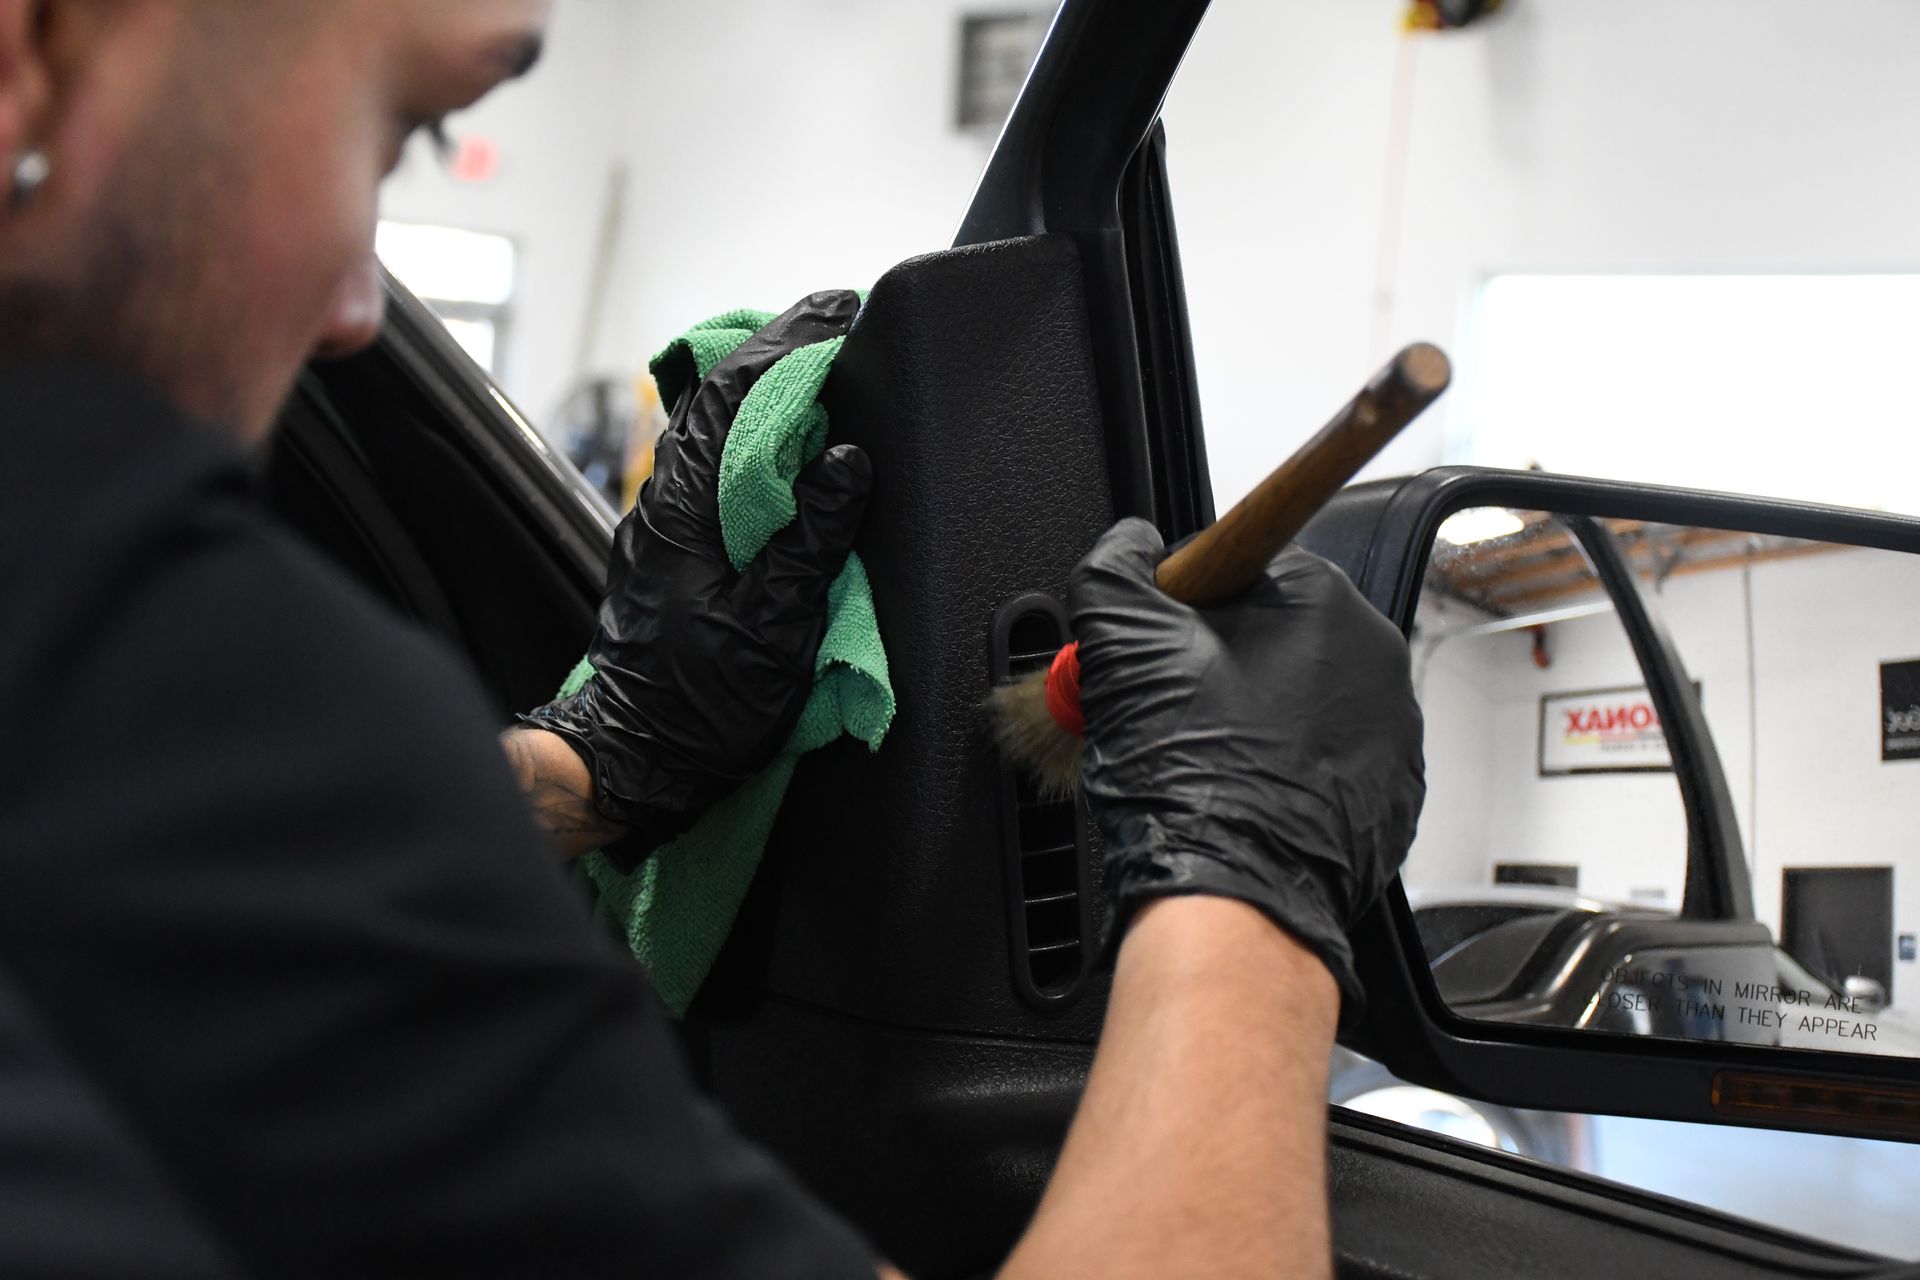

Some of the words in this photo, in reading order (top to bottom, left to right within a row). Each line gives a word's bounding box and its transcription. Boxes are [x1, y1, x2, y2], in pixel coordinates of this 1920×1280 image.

[1602, 966, 1688, 991] OBJECTS
[1703, 978, 1722, 996] IN
[1735, 981, 1811, 1007] MIRROR
[1824, 994, 1863, 1014] ARE
[1675, 998, 1725, 1021] THAN
[1738, 1006, 1788, 1029] THEY
[1798, 1015, 1877, 1041] APPEAR
